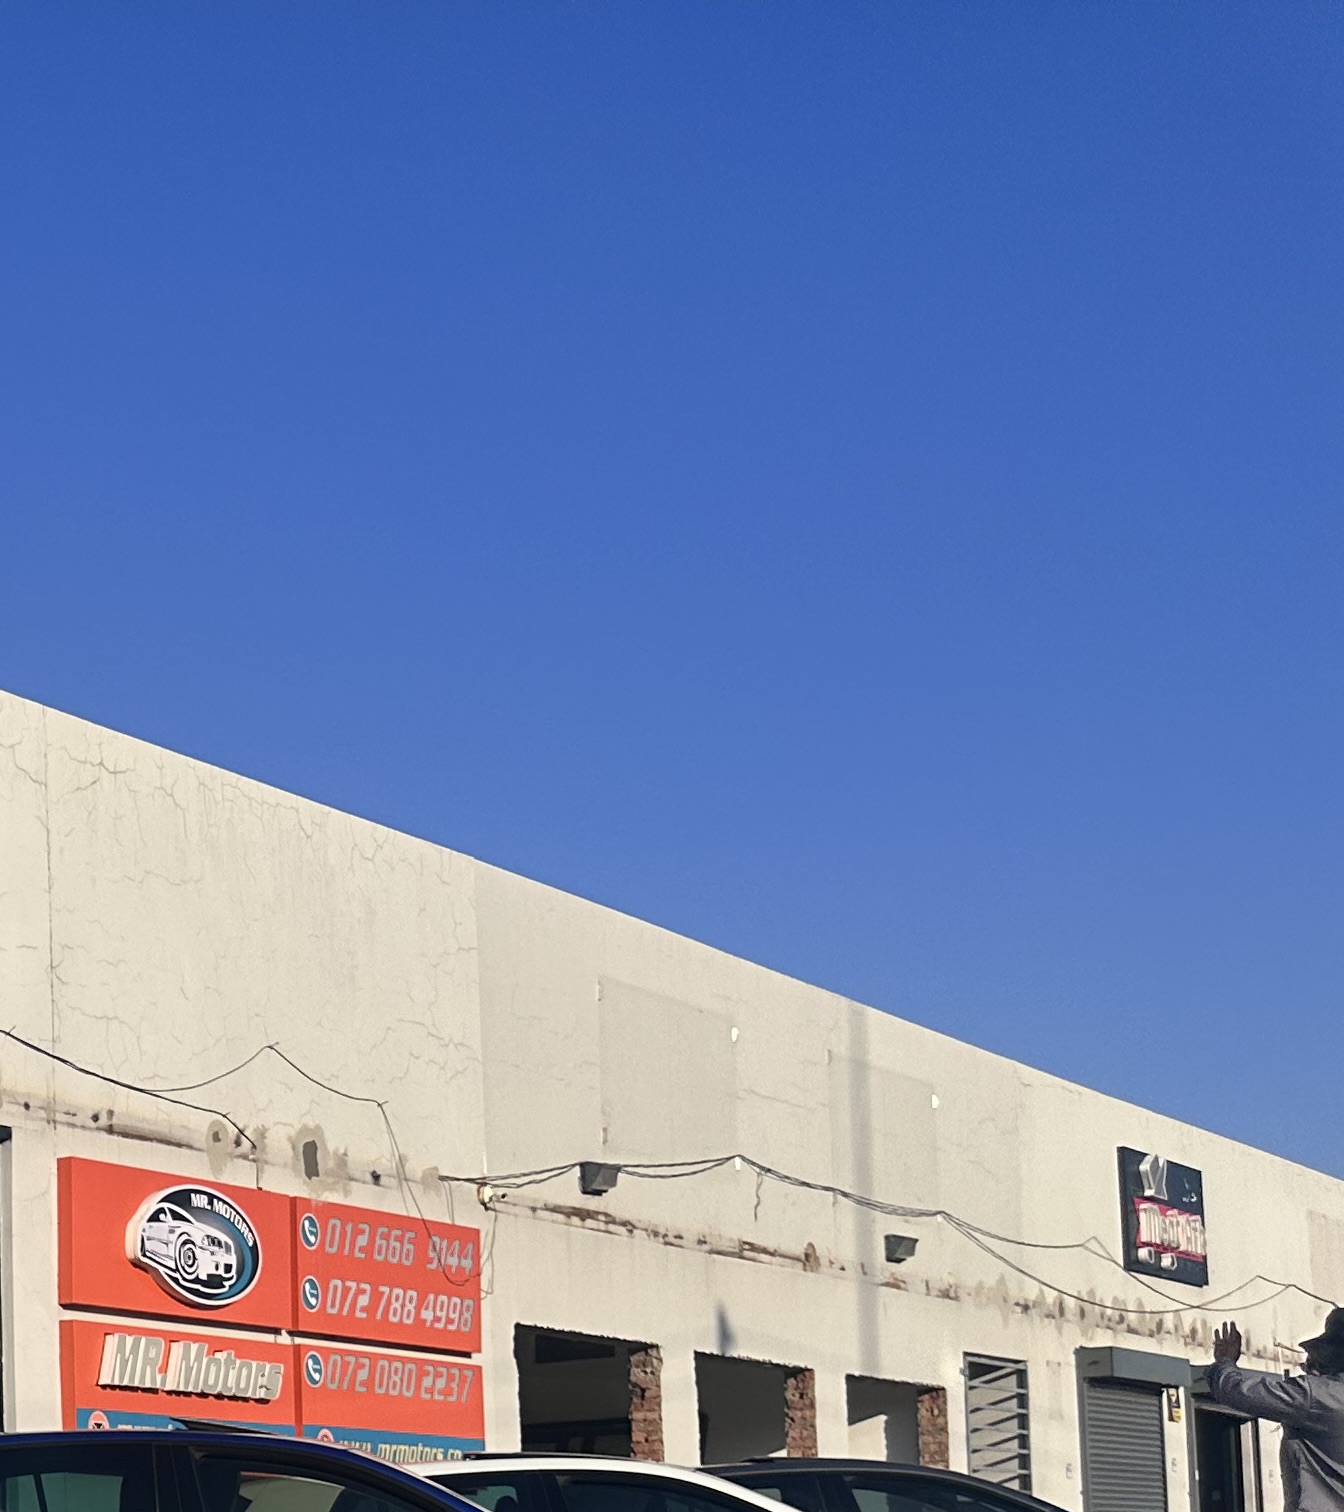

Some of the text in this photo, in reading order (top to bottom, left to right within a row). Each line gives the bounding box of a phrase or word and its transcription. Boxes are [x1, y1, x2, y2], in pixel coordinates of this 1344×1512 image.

[190, 1192, 254, 1247] MR. MOTORS
[325, 1217, 474, 1275] 012 666 9144
[325, 1278, 475, 1333] 072 788 4998
[99, 1333, 283, 1401] MR. Motors
[325, 1352, 474, 1404] 072 080 2237
